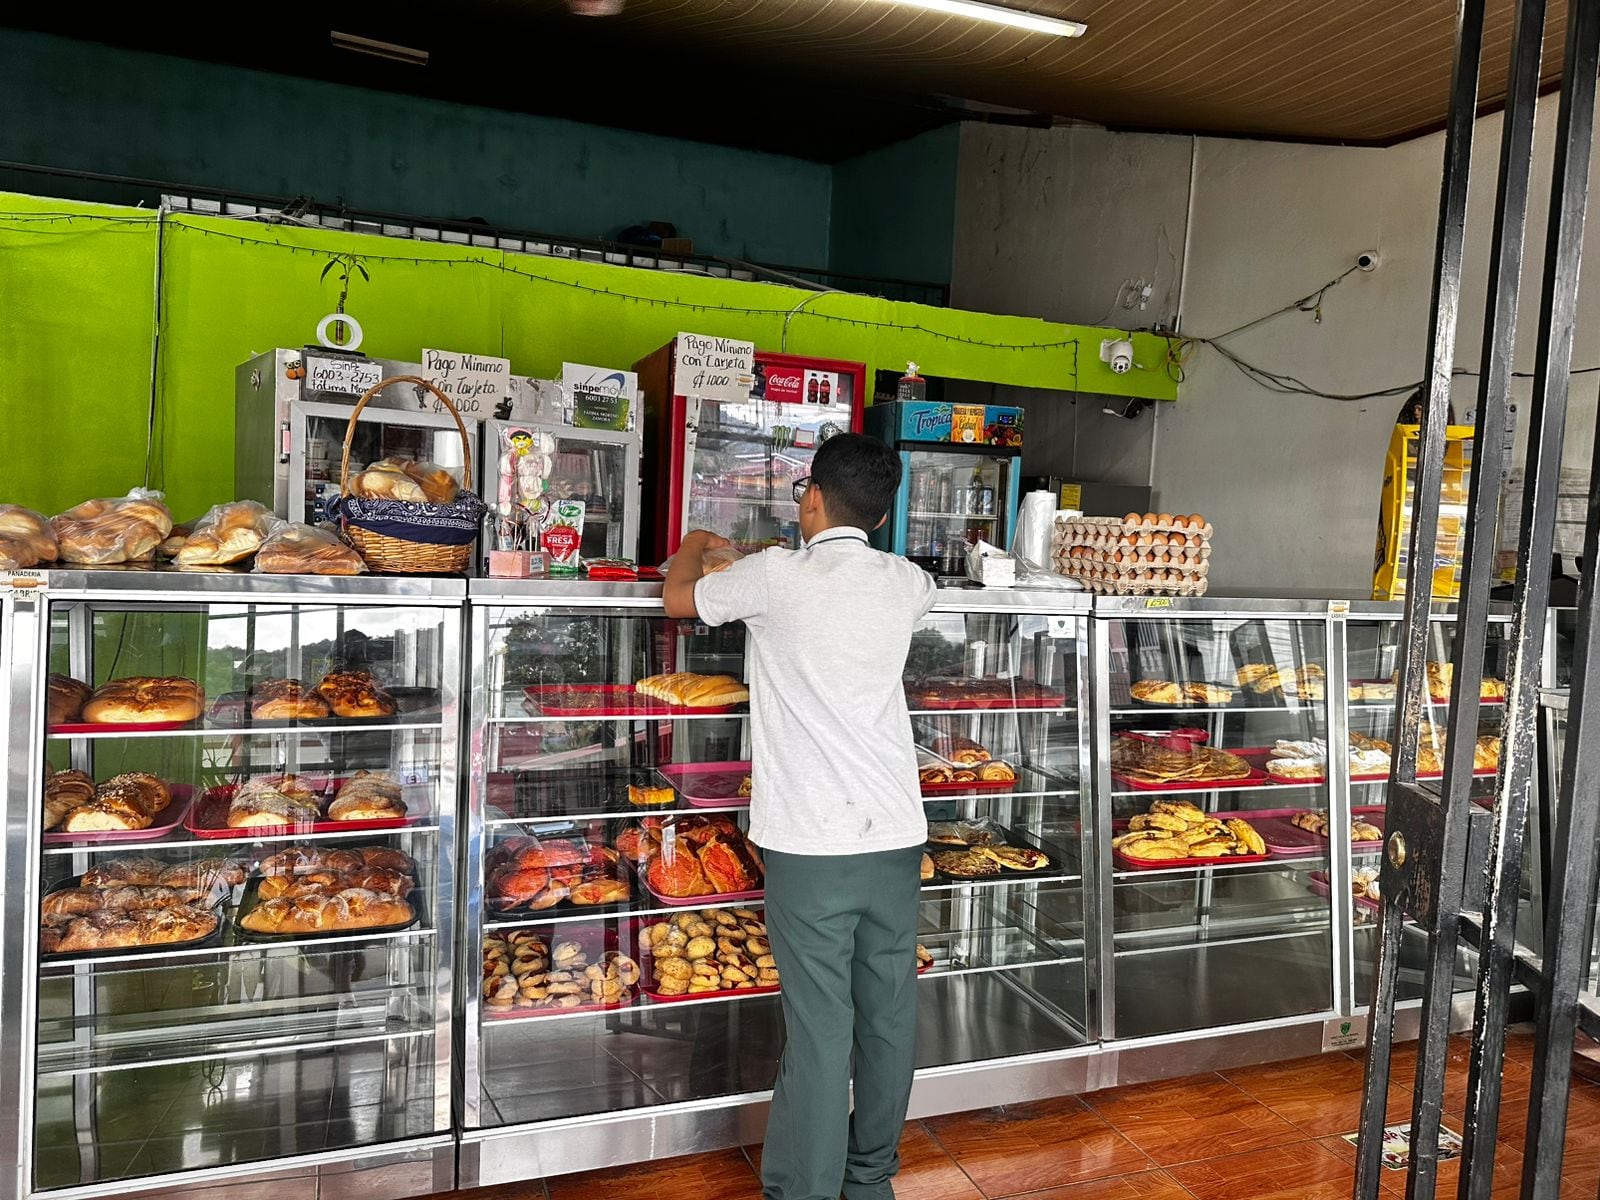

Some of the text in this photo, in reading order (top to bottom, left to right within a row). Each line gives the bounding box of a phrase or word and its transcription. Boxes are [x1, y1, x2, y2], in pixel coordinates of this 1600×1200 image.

[684, 334, 713, 356] Pago
[426, 350, 456, 378] Pago
[909, 409, 953, 434] Tropica
[547, 536, 574, 545] FRESA
